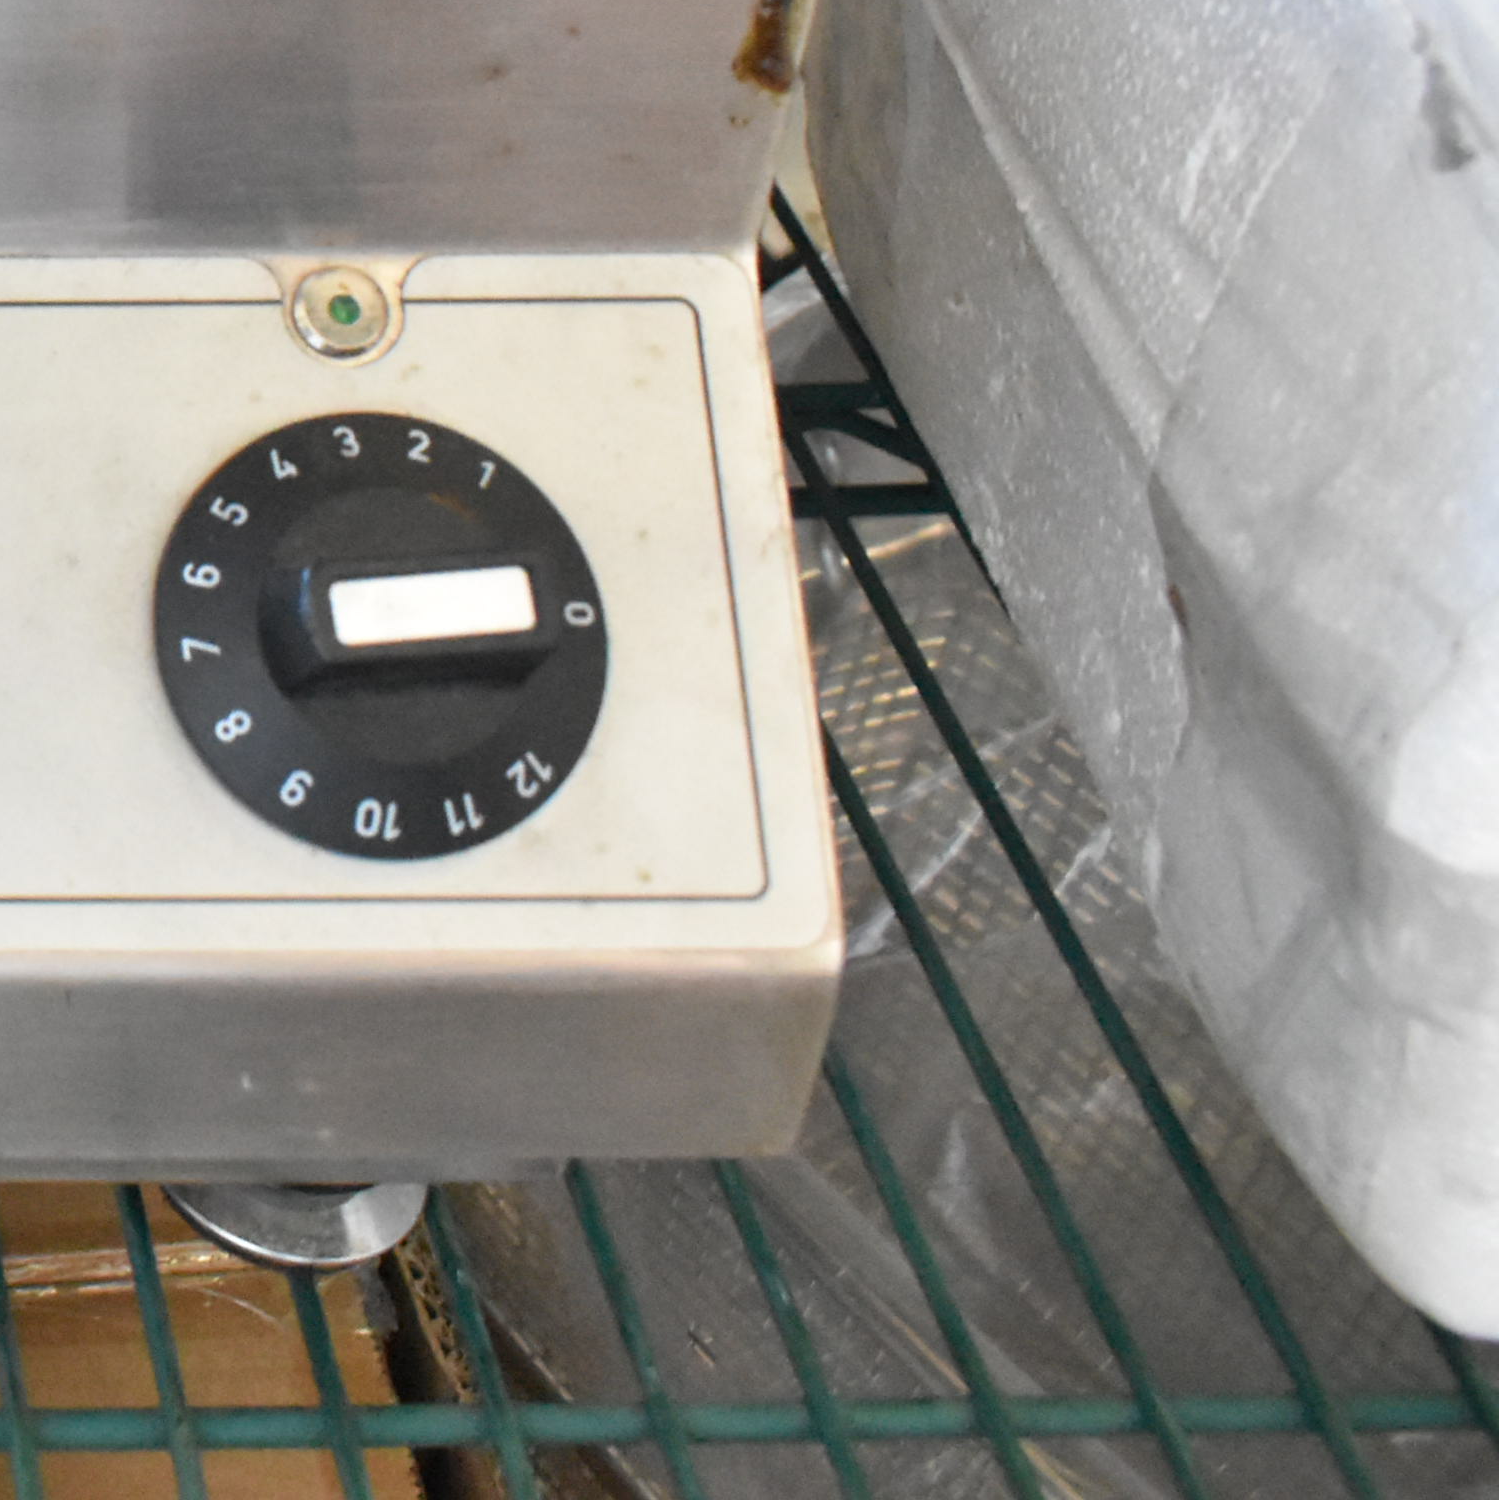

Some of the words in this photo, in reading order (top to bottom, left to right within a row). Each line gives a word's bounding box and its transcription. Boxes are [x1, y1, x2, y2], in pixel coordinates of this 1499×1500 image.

[332, 426, 360, 458] 3
[407, 430, 432, 463] 2
[270, 449, 298, 480] 4
[478, 460, 496, 490] 1
[210, 496, 249, 526] 5
[182, 561, 222, 589] 6
[564, 601, 596, 627] 0
[181, 636, 222, 662] 7
[214, 709, 252, 742] 8
[279, 770, 314, 808] 9
[505, 751, 553, 799] 12
[353, 797, 402, 842] 10
[443, 792, 485, 835] 11
